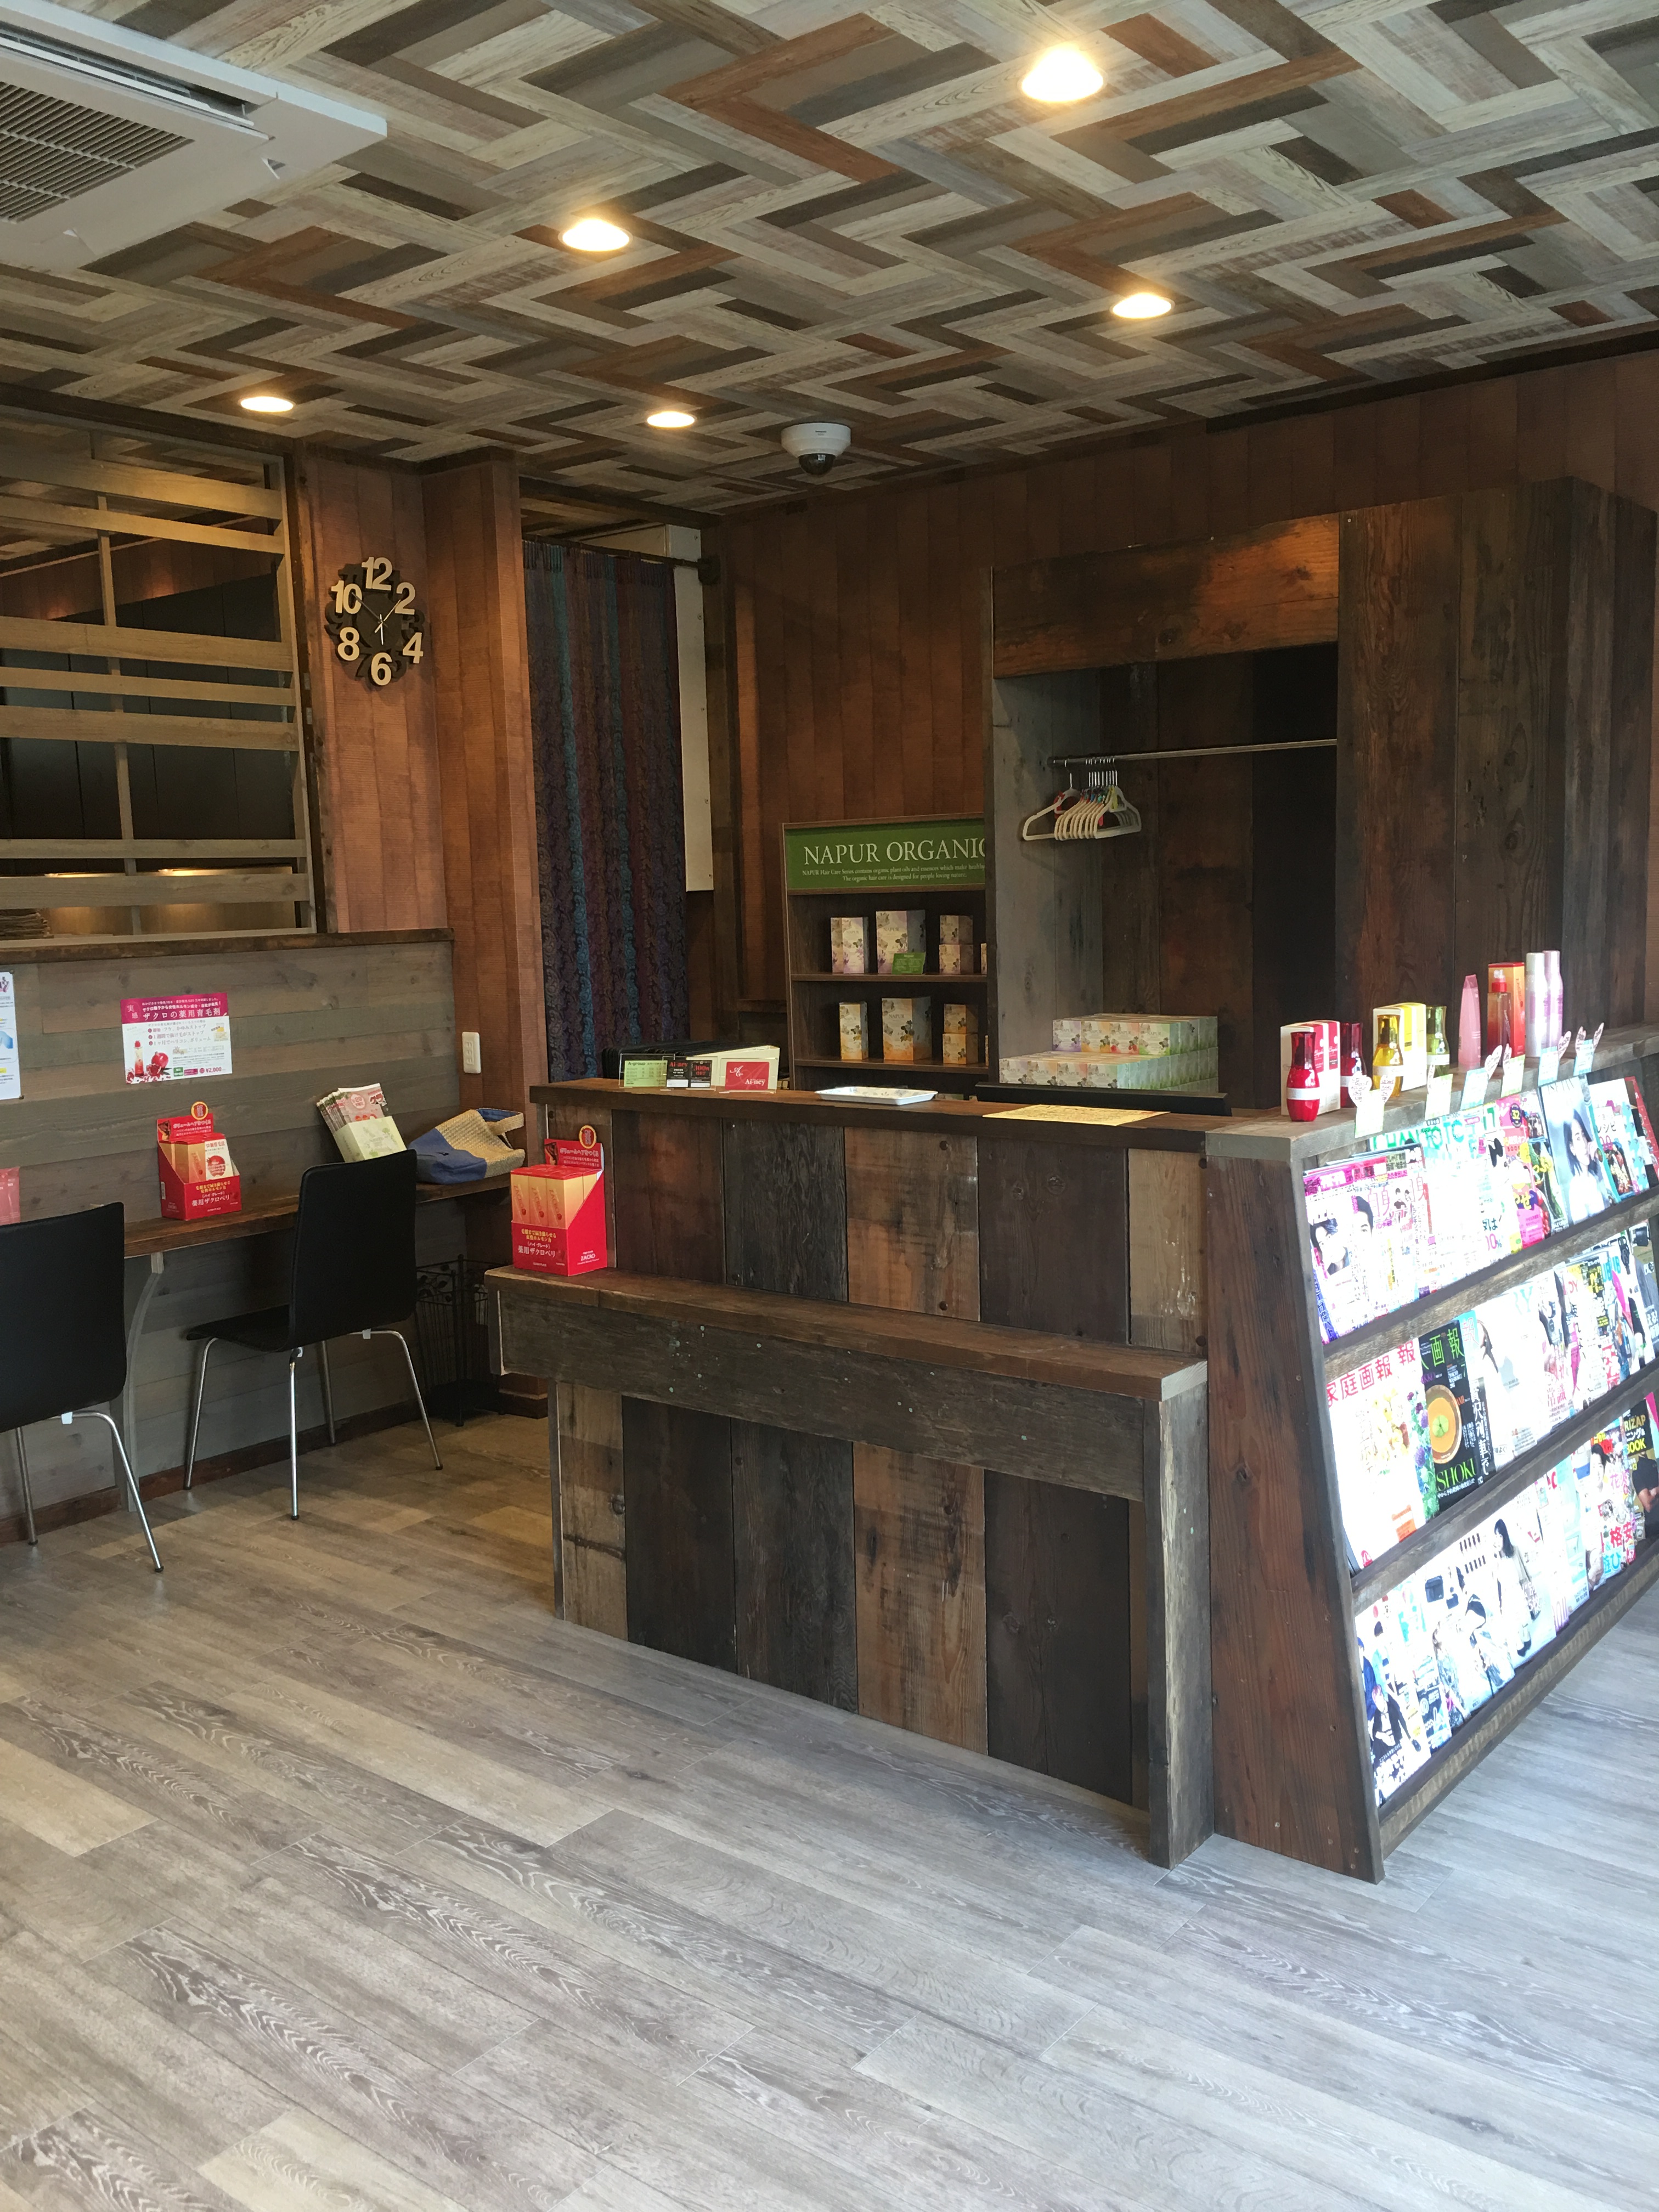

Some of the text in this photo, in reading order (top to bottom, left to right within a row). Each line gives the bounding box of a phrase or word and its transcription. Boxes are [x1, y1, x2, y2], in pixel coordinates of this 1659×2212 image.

[362, 557, 392, 591] 12
[331, 580, 362, 614] 10
[395, 582, 415, 615] 2
[338, 627, 359, 661] 8
[403, 633, 424, 664] 4
[371, 652, 392, 686] 6
[804, 843, 881, 865] NAPUR
[143, 1007, 221, 1021] ザクロの薬用育毛剤
[580, 1253, 596, 1261] ZACRO
[1397, 1340, 1416, 1366] 報
[1327, 1355, 1393, 1408] 家庭画報
[1624, 1414, 1646, 1432] RIZAP
